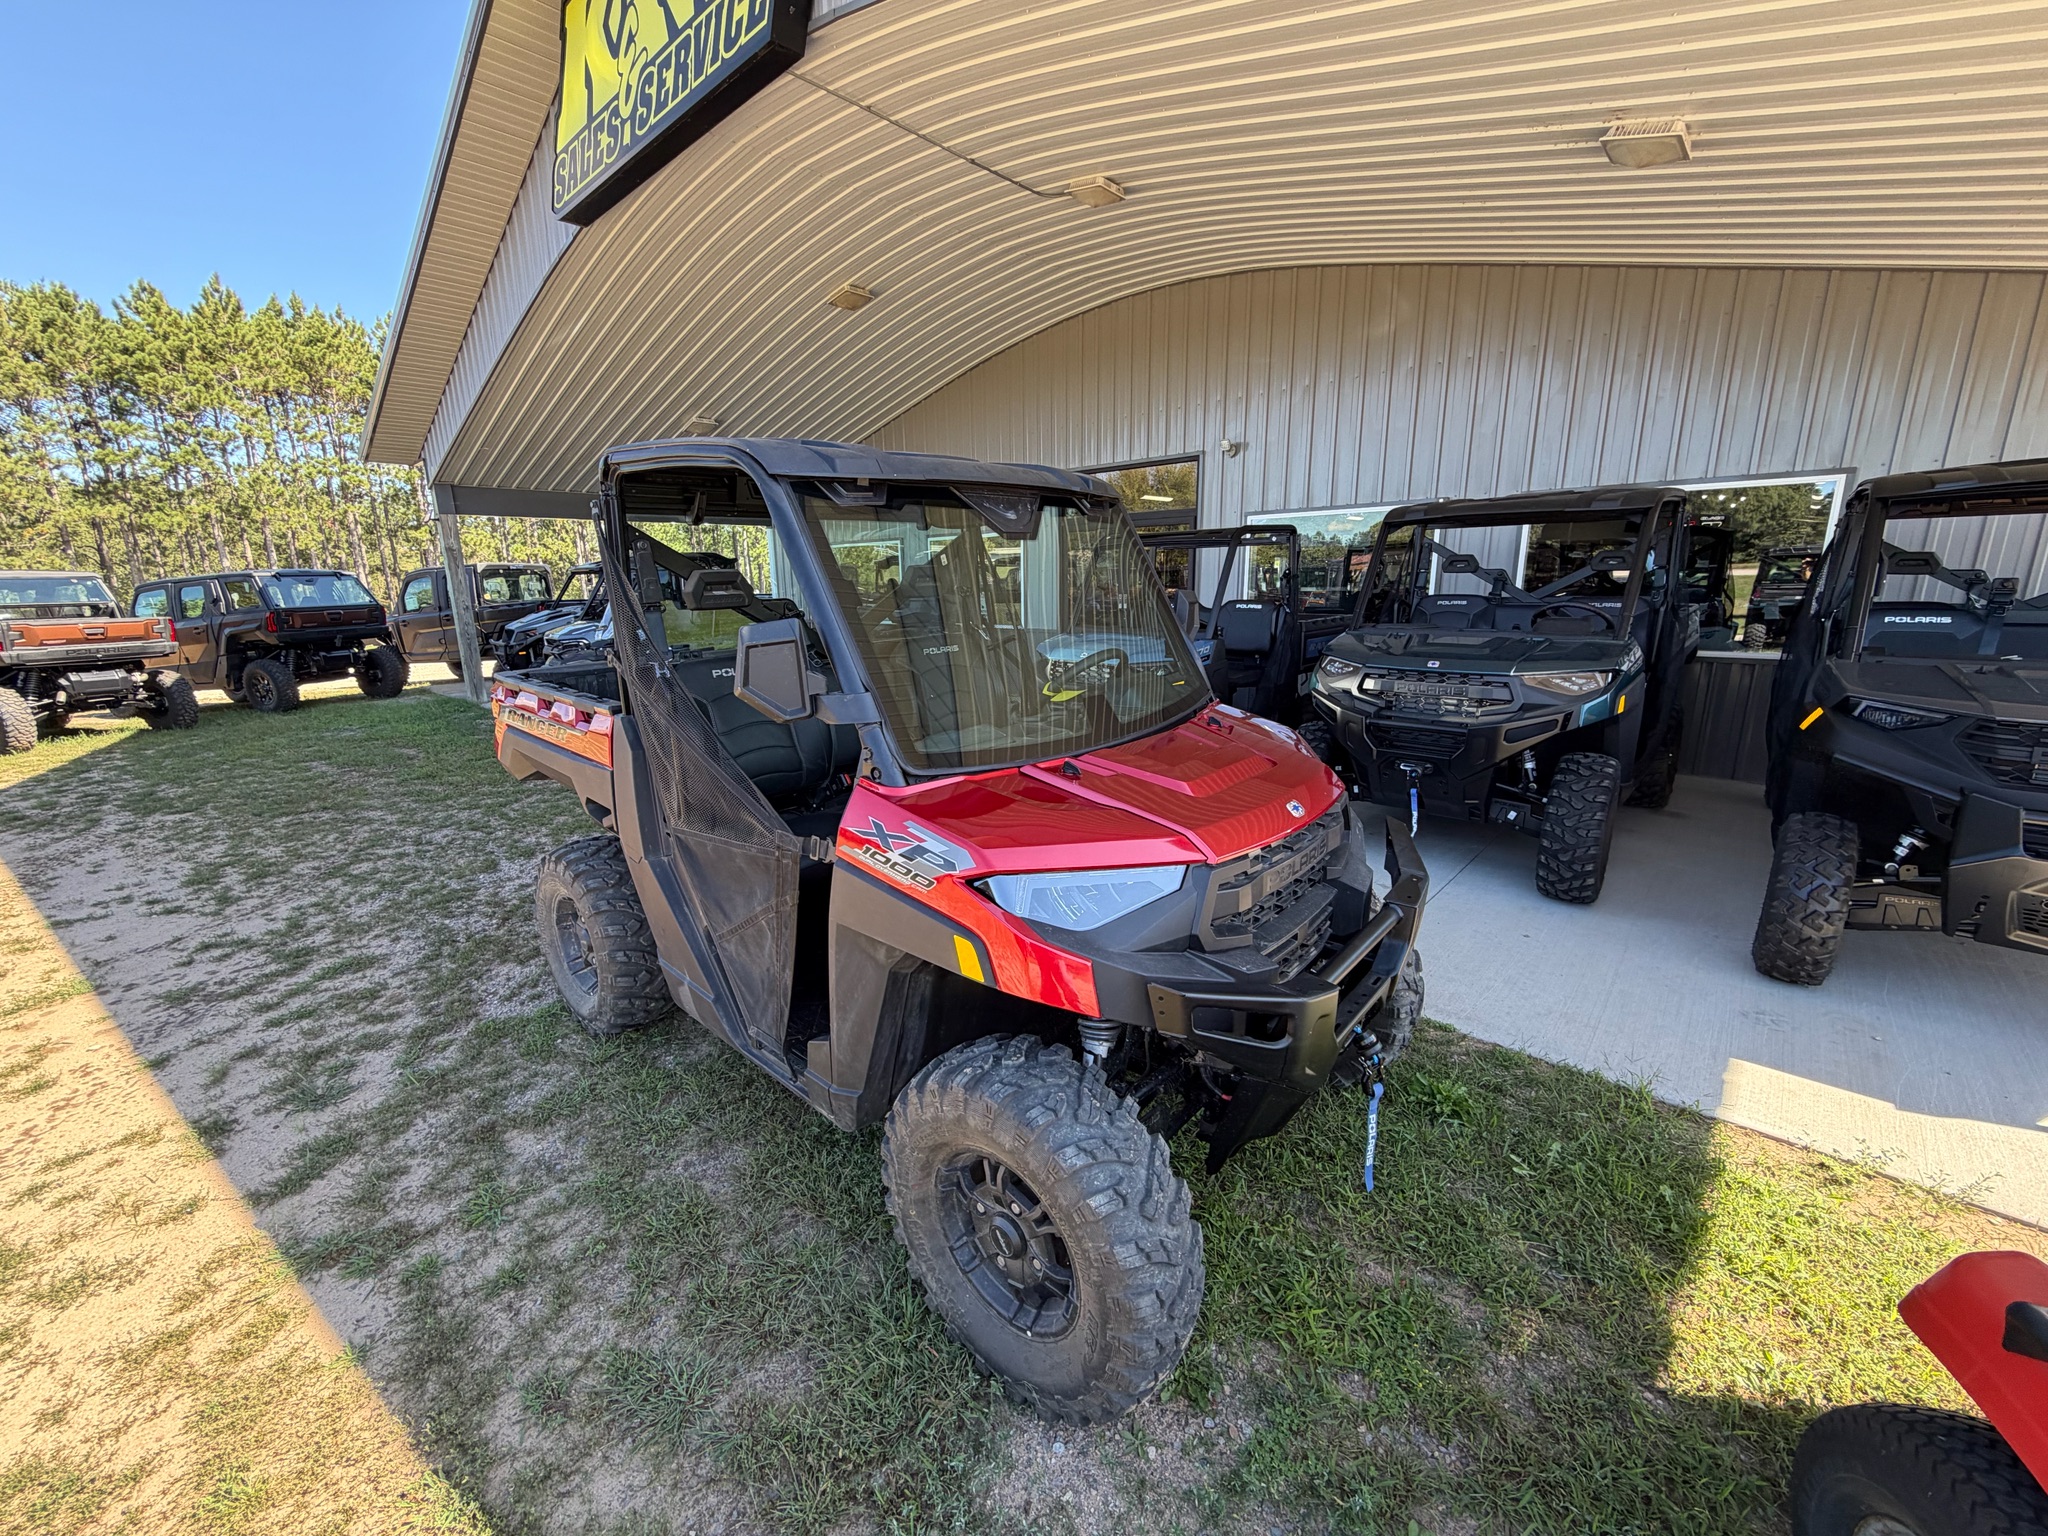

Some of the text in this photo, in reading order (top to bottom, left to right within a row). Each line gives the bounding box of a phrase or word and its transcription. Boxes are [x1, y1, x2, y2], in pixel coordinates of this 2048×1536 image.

[554, 98, 621, 206] SALES
[66, 646, 130, 656] POLARIS
[923, 644, 959, 655] POLARIS
[1397, 682, 1467, 696] POLARIS
[505, 707, 568, 742] RANGER
[847, 815, 960, 874] XP
[861, 844, 937, 891] 1000
[1266, 837, 1327, 892] POLARIS
[1366, 1113, 1377, 1167] POLARIS
